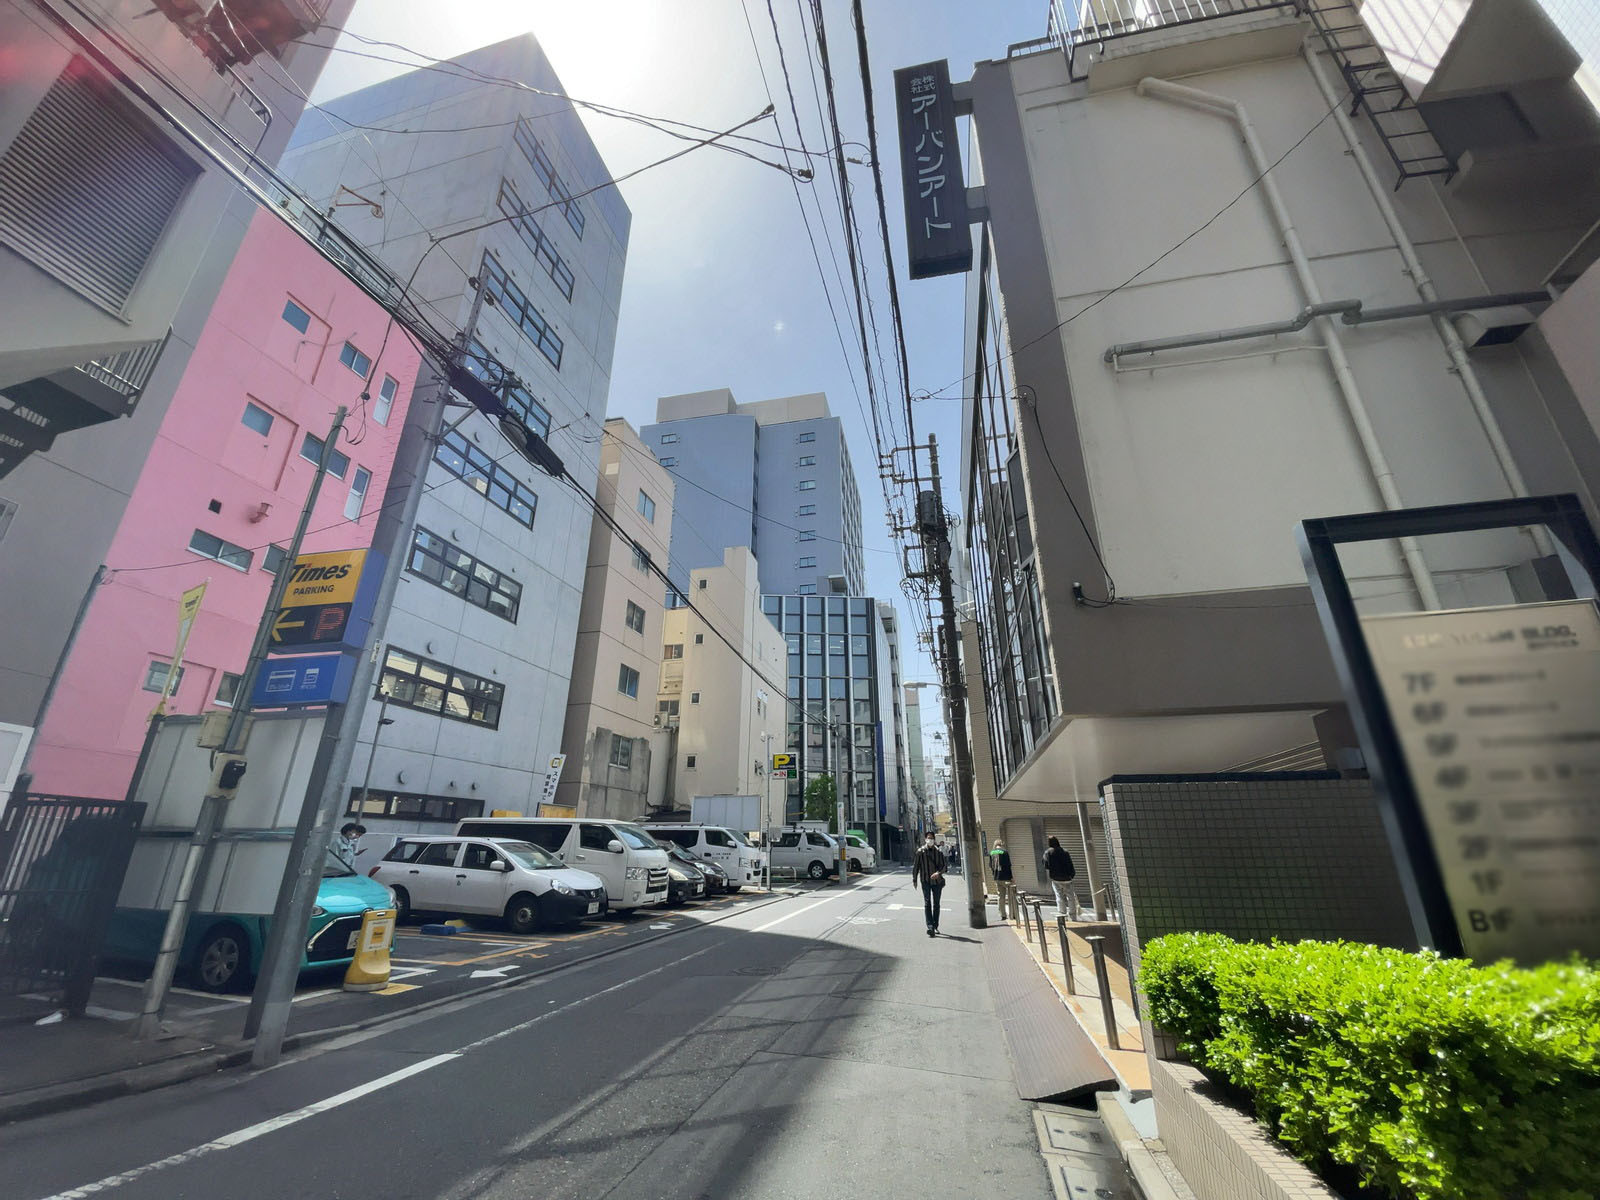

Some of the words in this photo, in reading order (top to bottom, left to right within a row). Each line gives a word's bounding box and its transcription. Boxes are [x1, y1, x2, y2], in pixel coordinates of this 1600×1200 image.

[911, 93, 952, 239] アーバンアート
[289, 562, 352, 583] Times
[293, 584, 335, 596] PARKING
